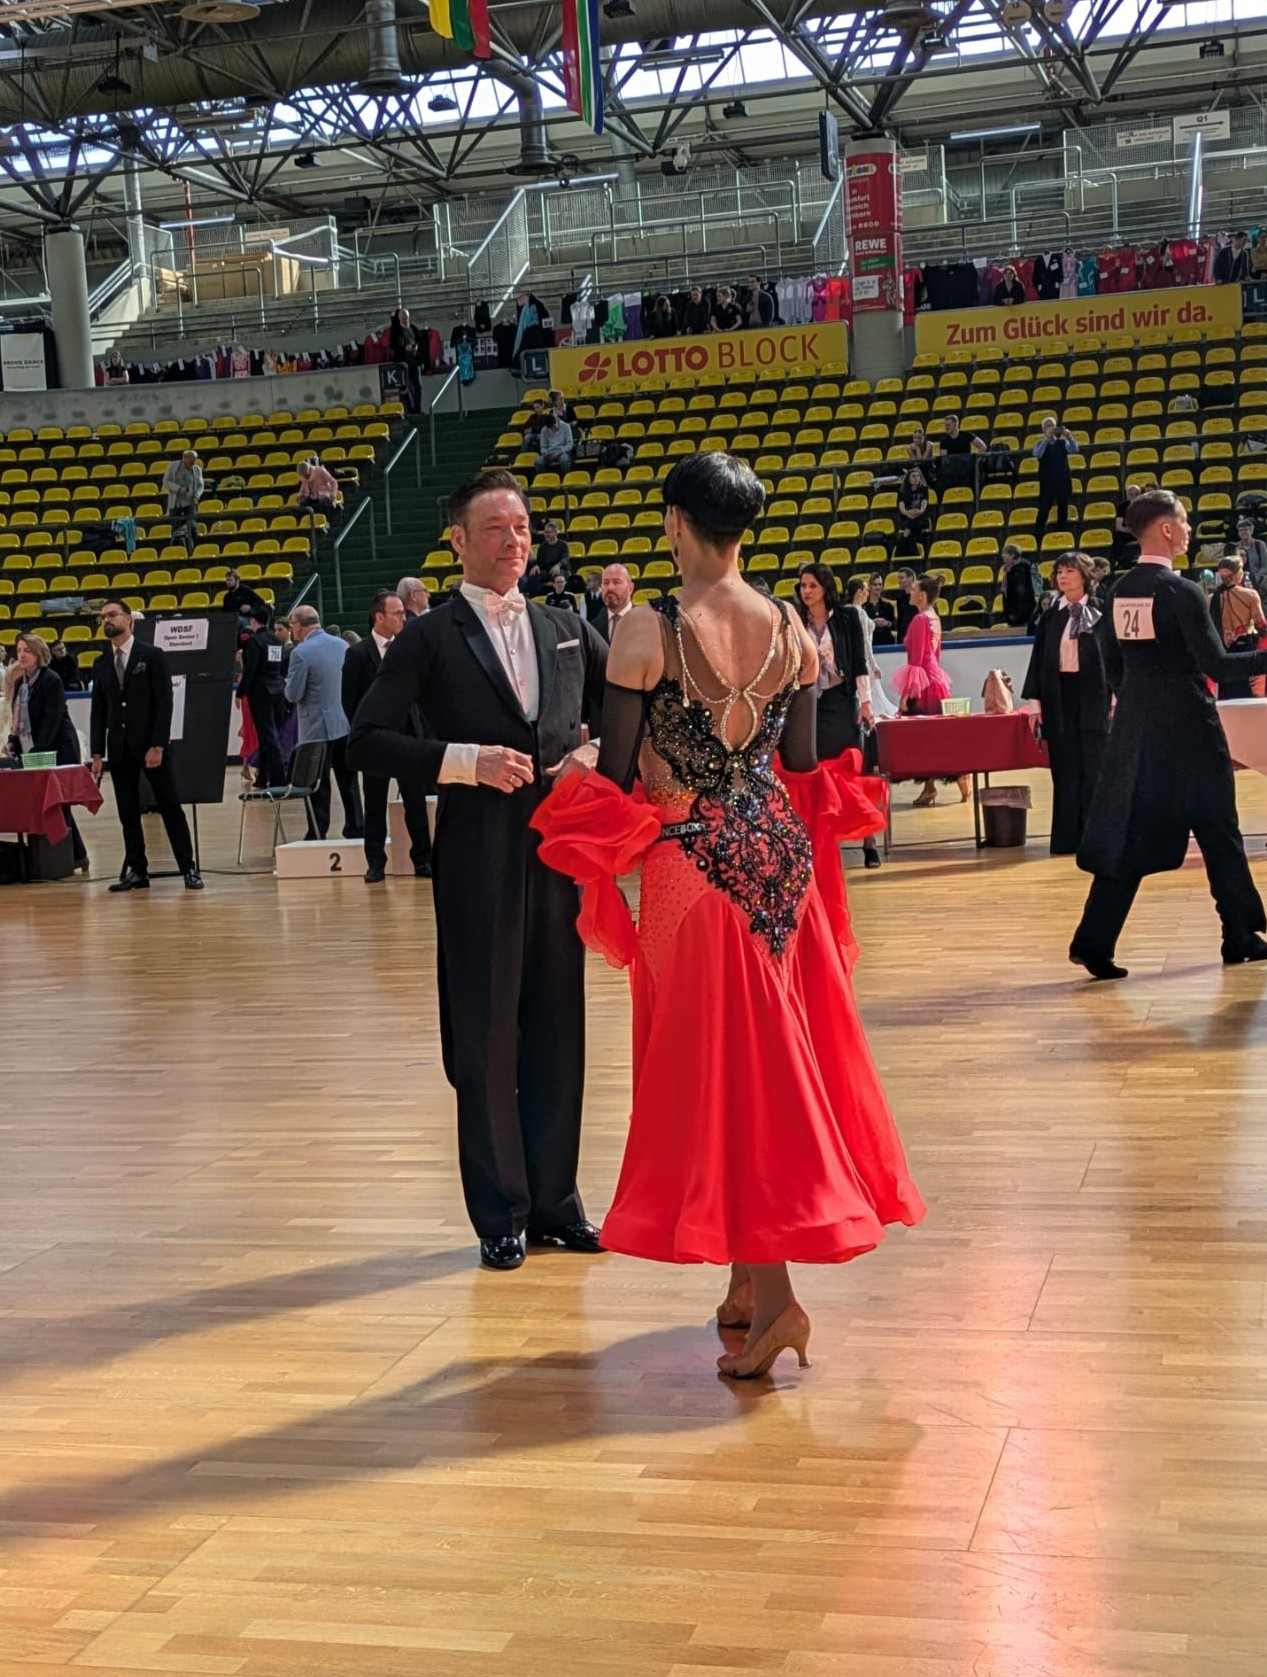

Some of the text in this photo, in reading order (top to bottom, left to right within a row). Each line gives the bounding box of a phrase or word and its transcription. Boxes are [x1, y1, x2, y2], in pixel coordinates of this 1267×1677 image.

[1196, 115, 1208, 123] Q1
[855, 238, 887, 251] REWE
[946, 300, 1214, 346] Zum Glück sind wir da.
[616, 332, 820, 378] LOTTO BLOCK
[532, 357, 543, 371] L
[387, 370, 398, 384] K
[170, 624, 193, 634] WDSF
[1123, 609, 1140, 639] 24
[662, 823, 701, 837] NCEBOX
[329, 852, 342, 872] 2
